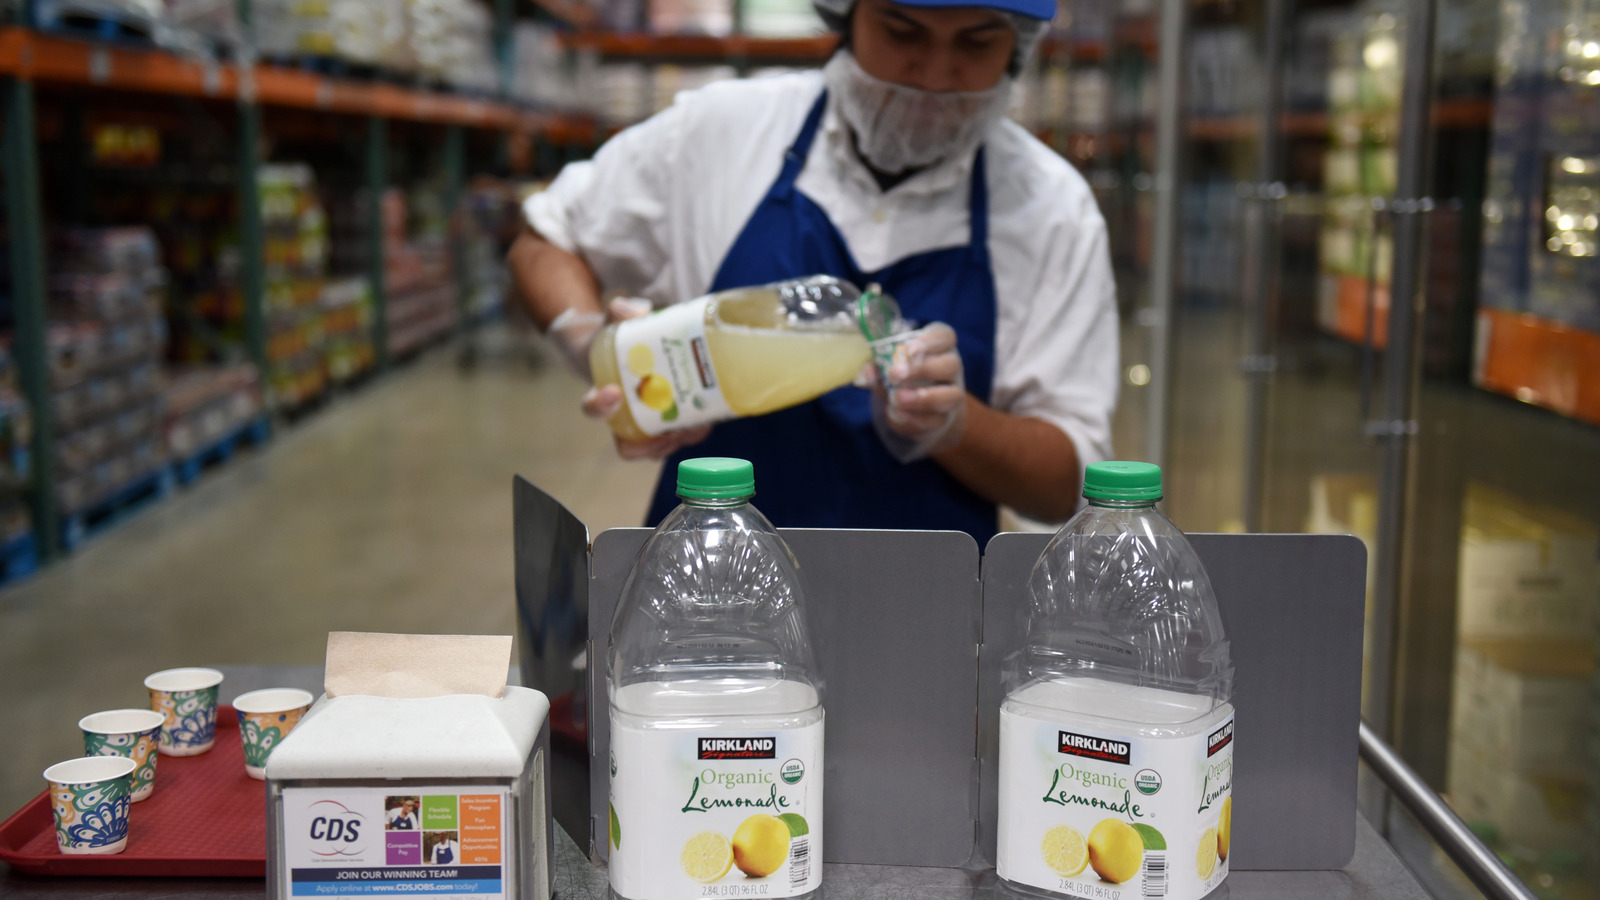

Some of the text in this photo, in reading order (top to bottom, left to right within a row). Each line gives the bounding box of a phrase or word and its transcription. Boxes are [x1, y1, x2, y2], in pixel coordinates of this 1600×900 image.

[702, 739, 774, 751] KIRKLAND
[1062, 733, 1128, 755] KIRKLAND
[1209, 722, 1232, 748] KIRKLAND
[702, 751, 773, 760] Signature
[1062, 745, 1128, 762] Signature
[701, 768, 773, 789] Organic
[786, 764, 800, 772] USDA
[1060, 762, 1127, 789] Organic
[681, 776, 790, 813] Lemonade
[1042, 768, 1144, 821] Lemonade
[310, 816, 361, 843] CDS
[336, 870, 458, 879] JOIN OUR WINNING TEAM!
[316, 885, 338, 894] Apply
[340, 884, 362, 892] online
[372, 883, 453, 892] www.CDSJOBS.com
[455, 882, 478, 891] today!
[702, 884, 769, 896] 2.84L (3 QT) 96 FL OZ
[1059, 879, 1121, 900] 2.84L (3 QT) 96 FL OZ
